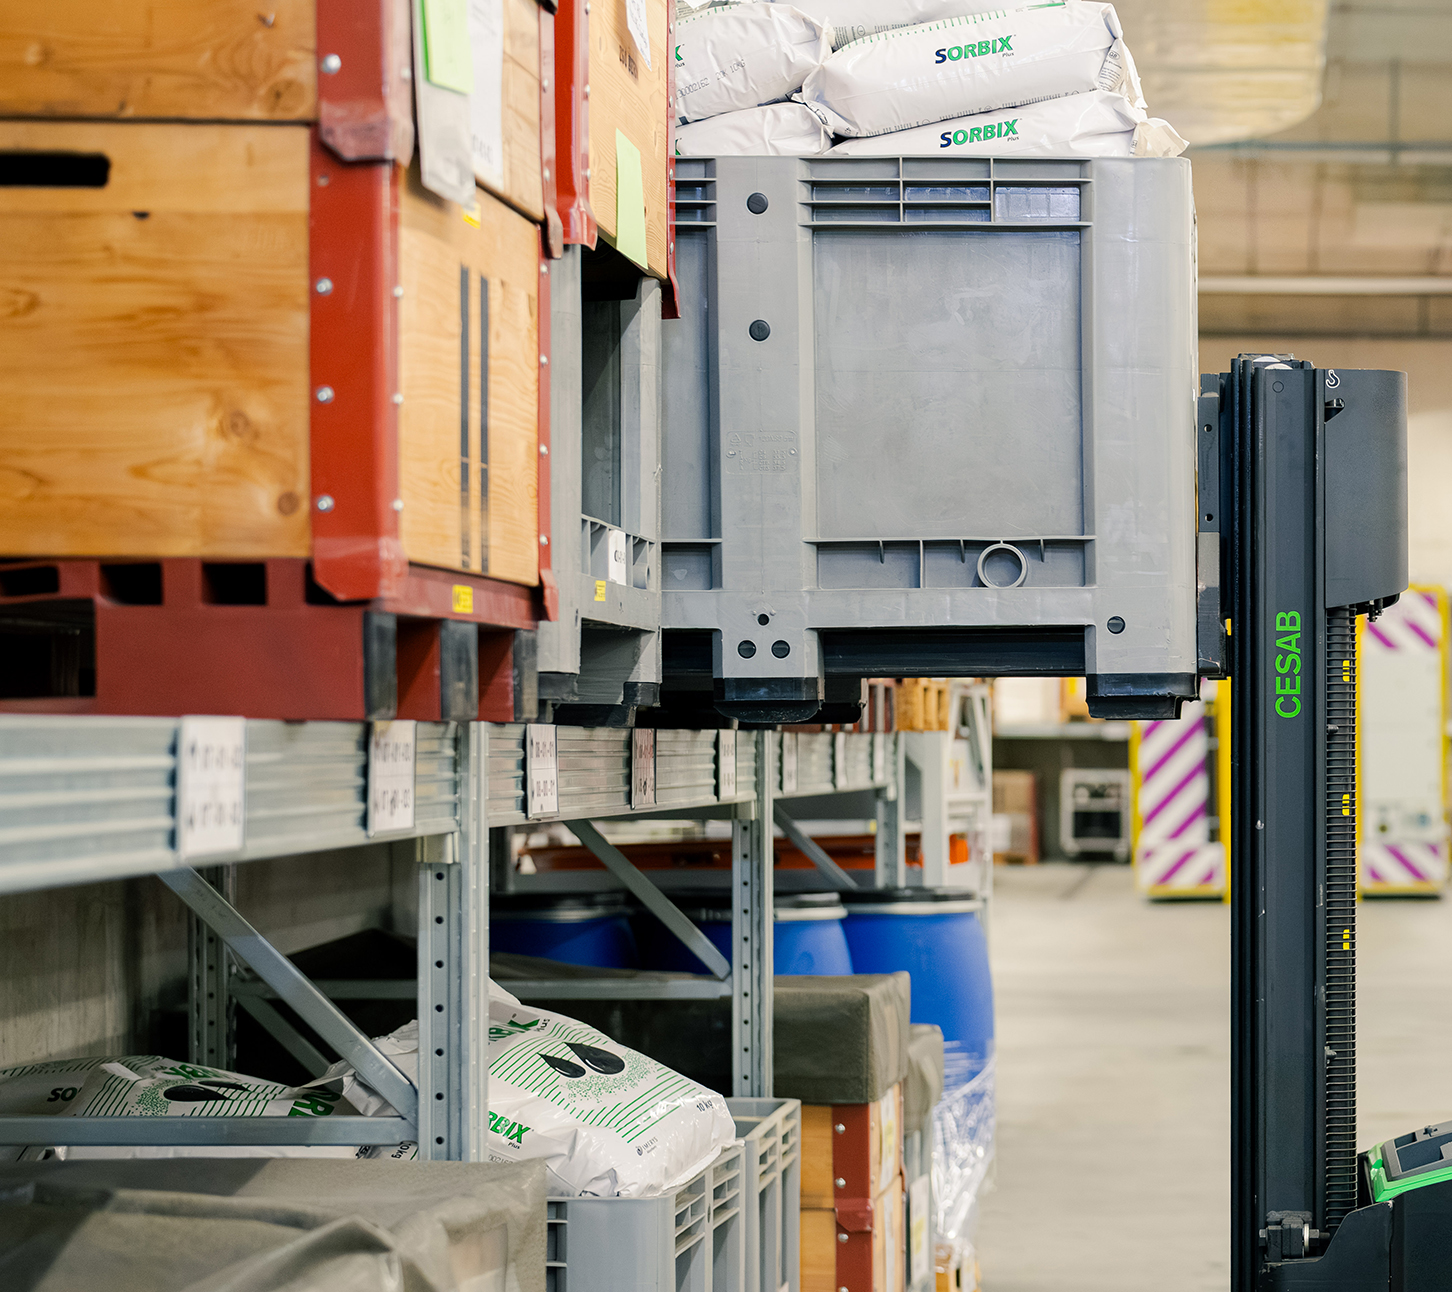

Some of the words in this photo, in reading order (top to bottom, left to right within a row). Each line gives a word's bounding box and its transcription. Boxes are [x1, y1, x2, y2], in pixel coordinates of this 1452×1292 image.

[935, 34, 1014, 64] SORBIX
[939, 118, 1019, 148] SORBIX
[1274, 610, 1302, 719] CESAB
[46, 1086, 82, 1102] SO
[488, 1110, 531, 1144] RBIX
